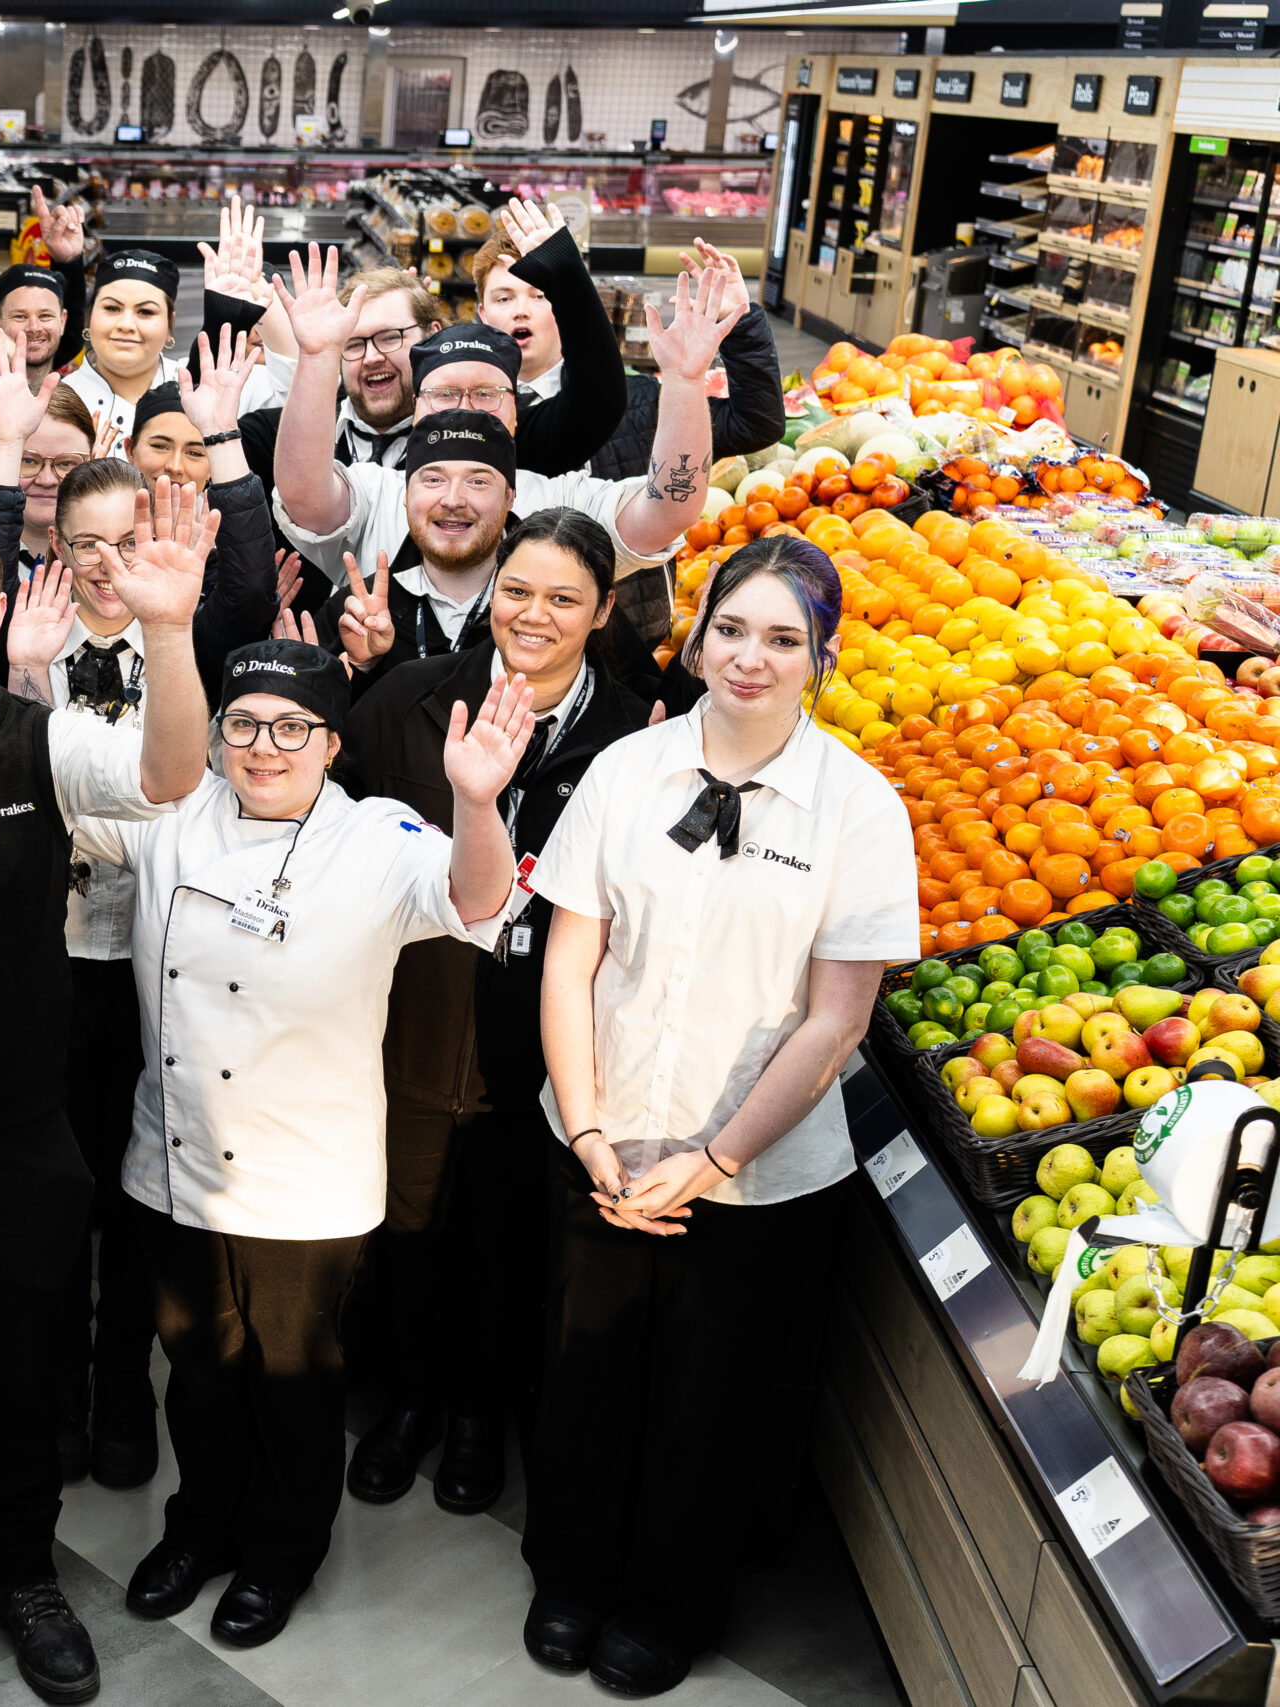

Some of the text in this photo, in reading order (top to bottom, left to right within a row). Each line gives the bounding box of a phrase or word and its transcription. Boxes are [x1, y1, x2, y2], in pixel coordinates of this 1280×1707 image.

[1075, 82, 1094, 103] Rolls
[1127, 85, 1150, 106] Pizza
[233, 907, 265, 924] Maddison
